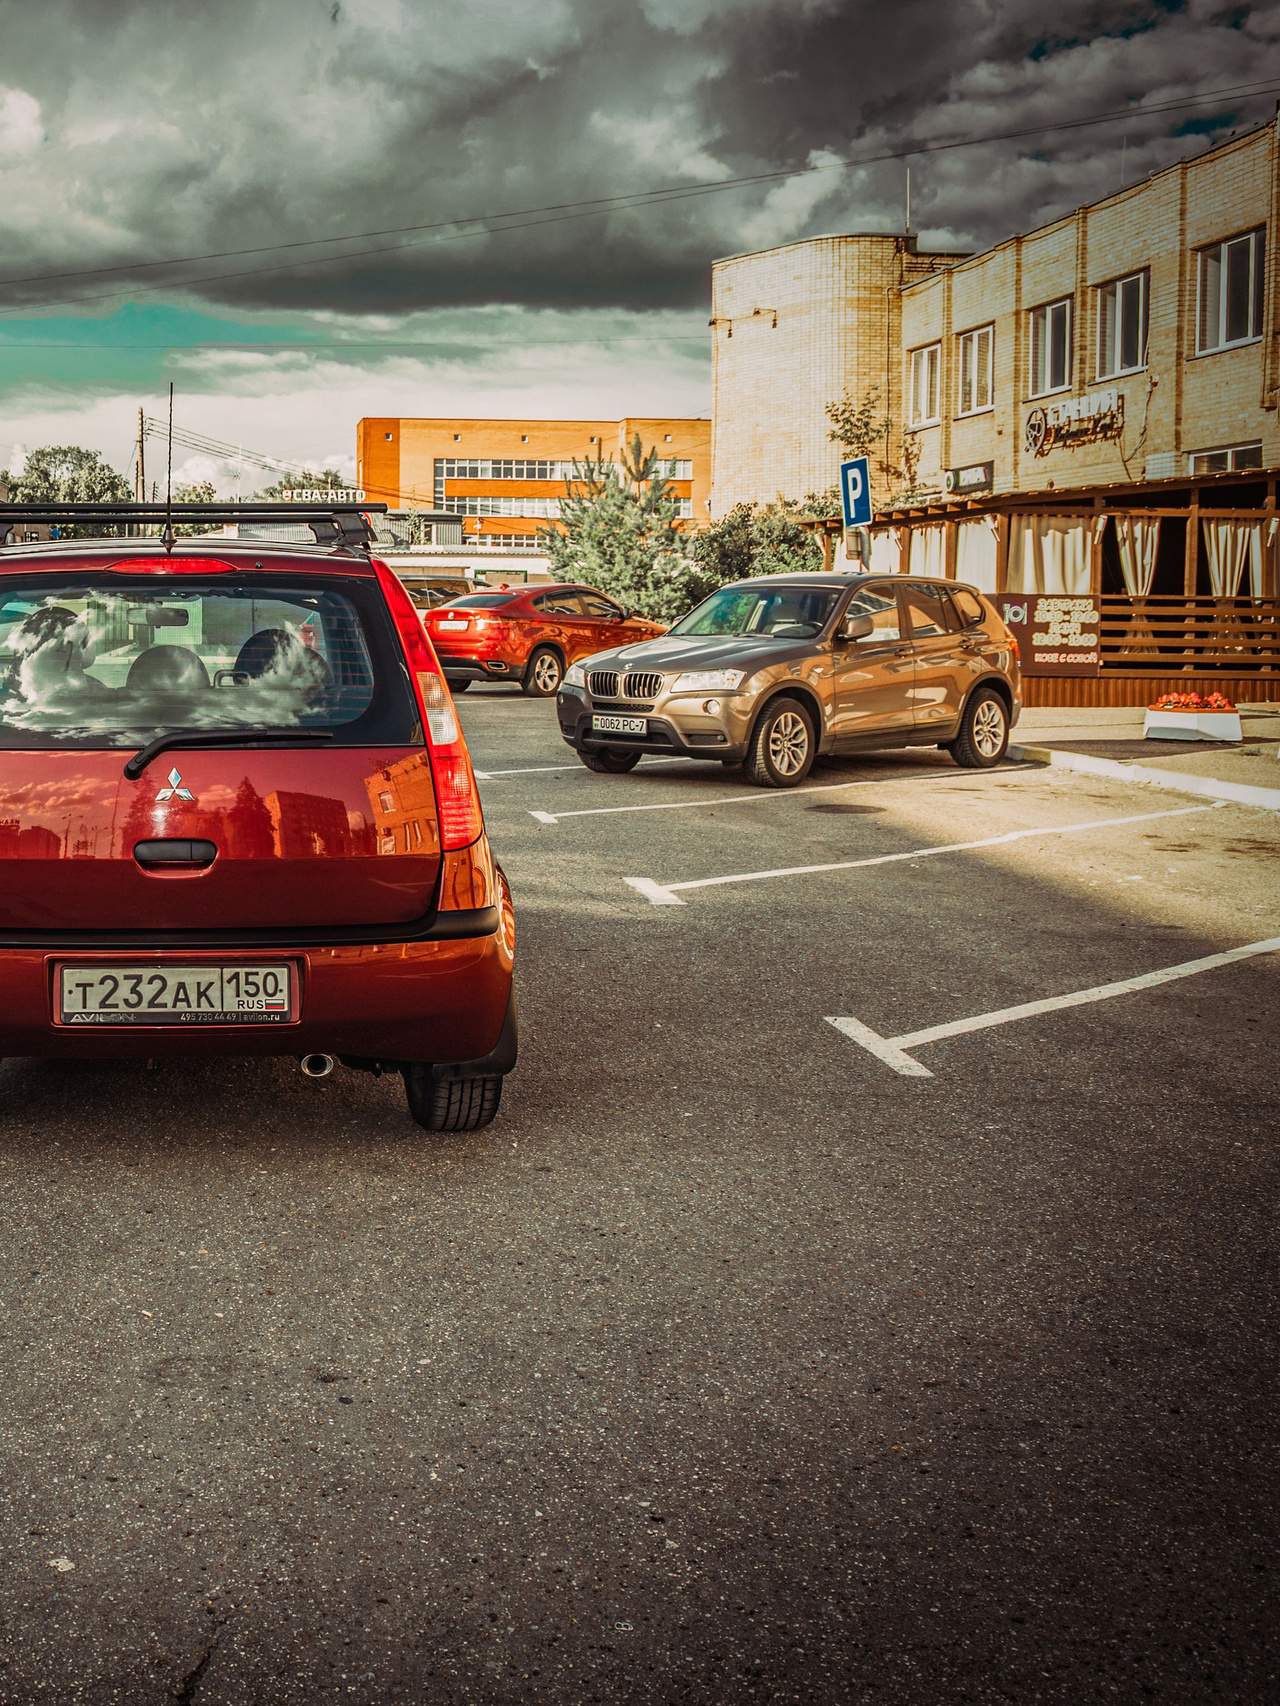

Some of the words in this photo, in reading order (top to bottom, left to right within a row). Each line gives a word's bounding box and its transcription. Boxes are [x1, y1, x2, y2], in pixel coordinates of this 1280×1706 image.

[1037, 598, 1094, 612] ЗАВТРАКИ
[1034, 610, 1063, 623] 10:30
[1070, 610, 1099, 623] 12:00
[1049, 622, 1081, 635] ЛАНЧ
[1032, 632, 1062, 646] 12:00
[1068, 632, 1098, 647] 16:00
[600, 717, 621, 730] 0062
[75, 974, 216, 1010] Т232АК
[226, 971, 279, 998] 150
[237, 999, 264, 1010] RUS
[180, 1013, 196, 1021] 495
[197, 1013, 213, 1021] 730
[214, 1013, 225, 1021] 44
[226, 1013, 237, 1021] 49
[243, 1012, 280, 1022] avilon.ru
